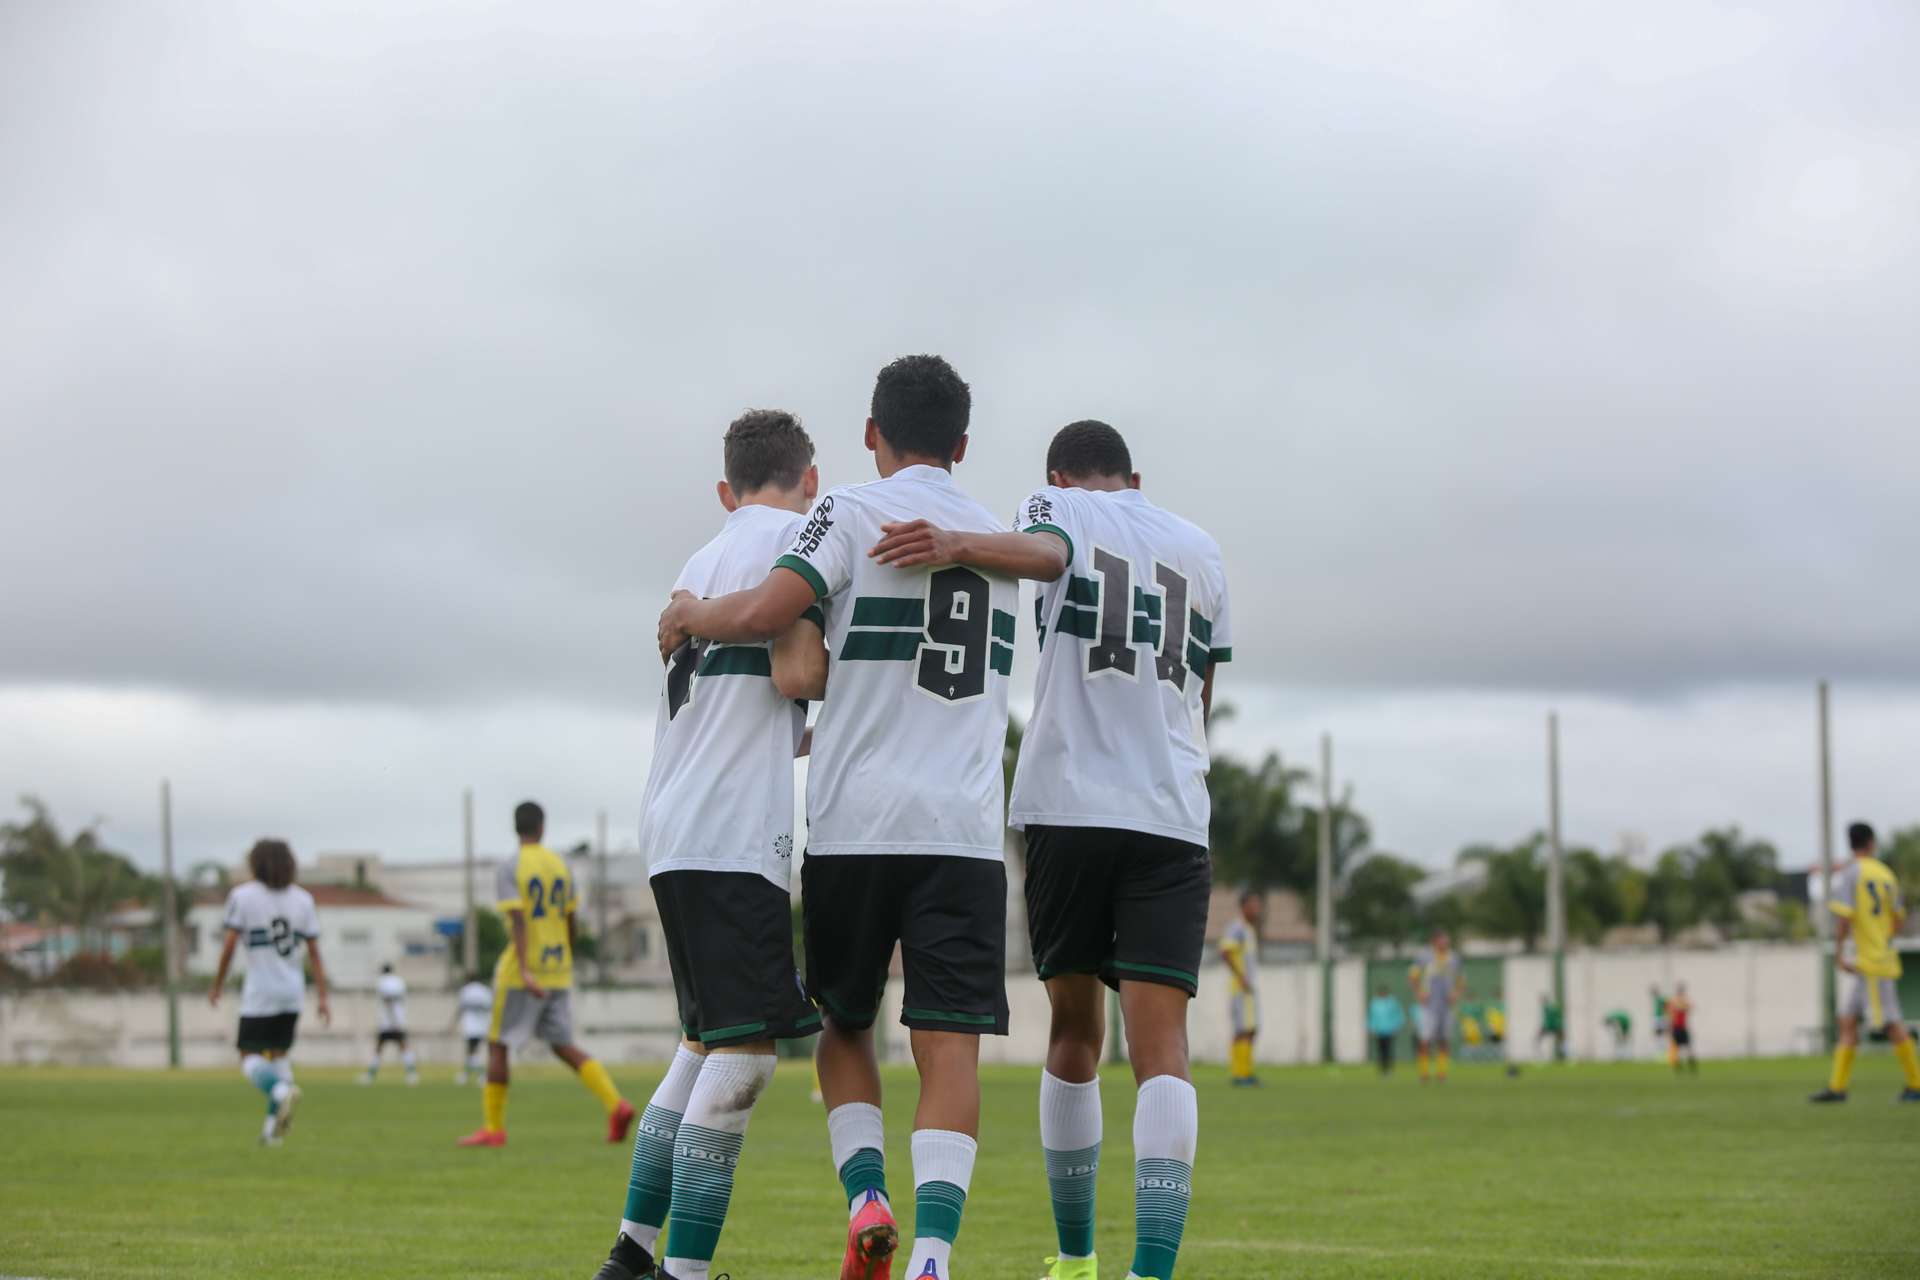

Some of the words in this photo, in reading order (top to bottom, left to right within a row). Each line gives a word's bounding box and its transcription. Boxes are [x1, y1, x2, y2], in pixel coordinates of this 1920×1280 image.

[799, 514, 834, 558] TORK
[914, 566, 990, 703] 9
[1084, 545, 1190, 698] 11
[270, 916, 292, 958] 2
[1138, 1178, 1191, 1194] 1909
